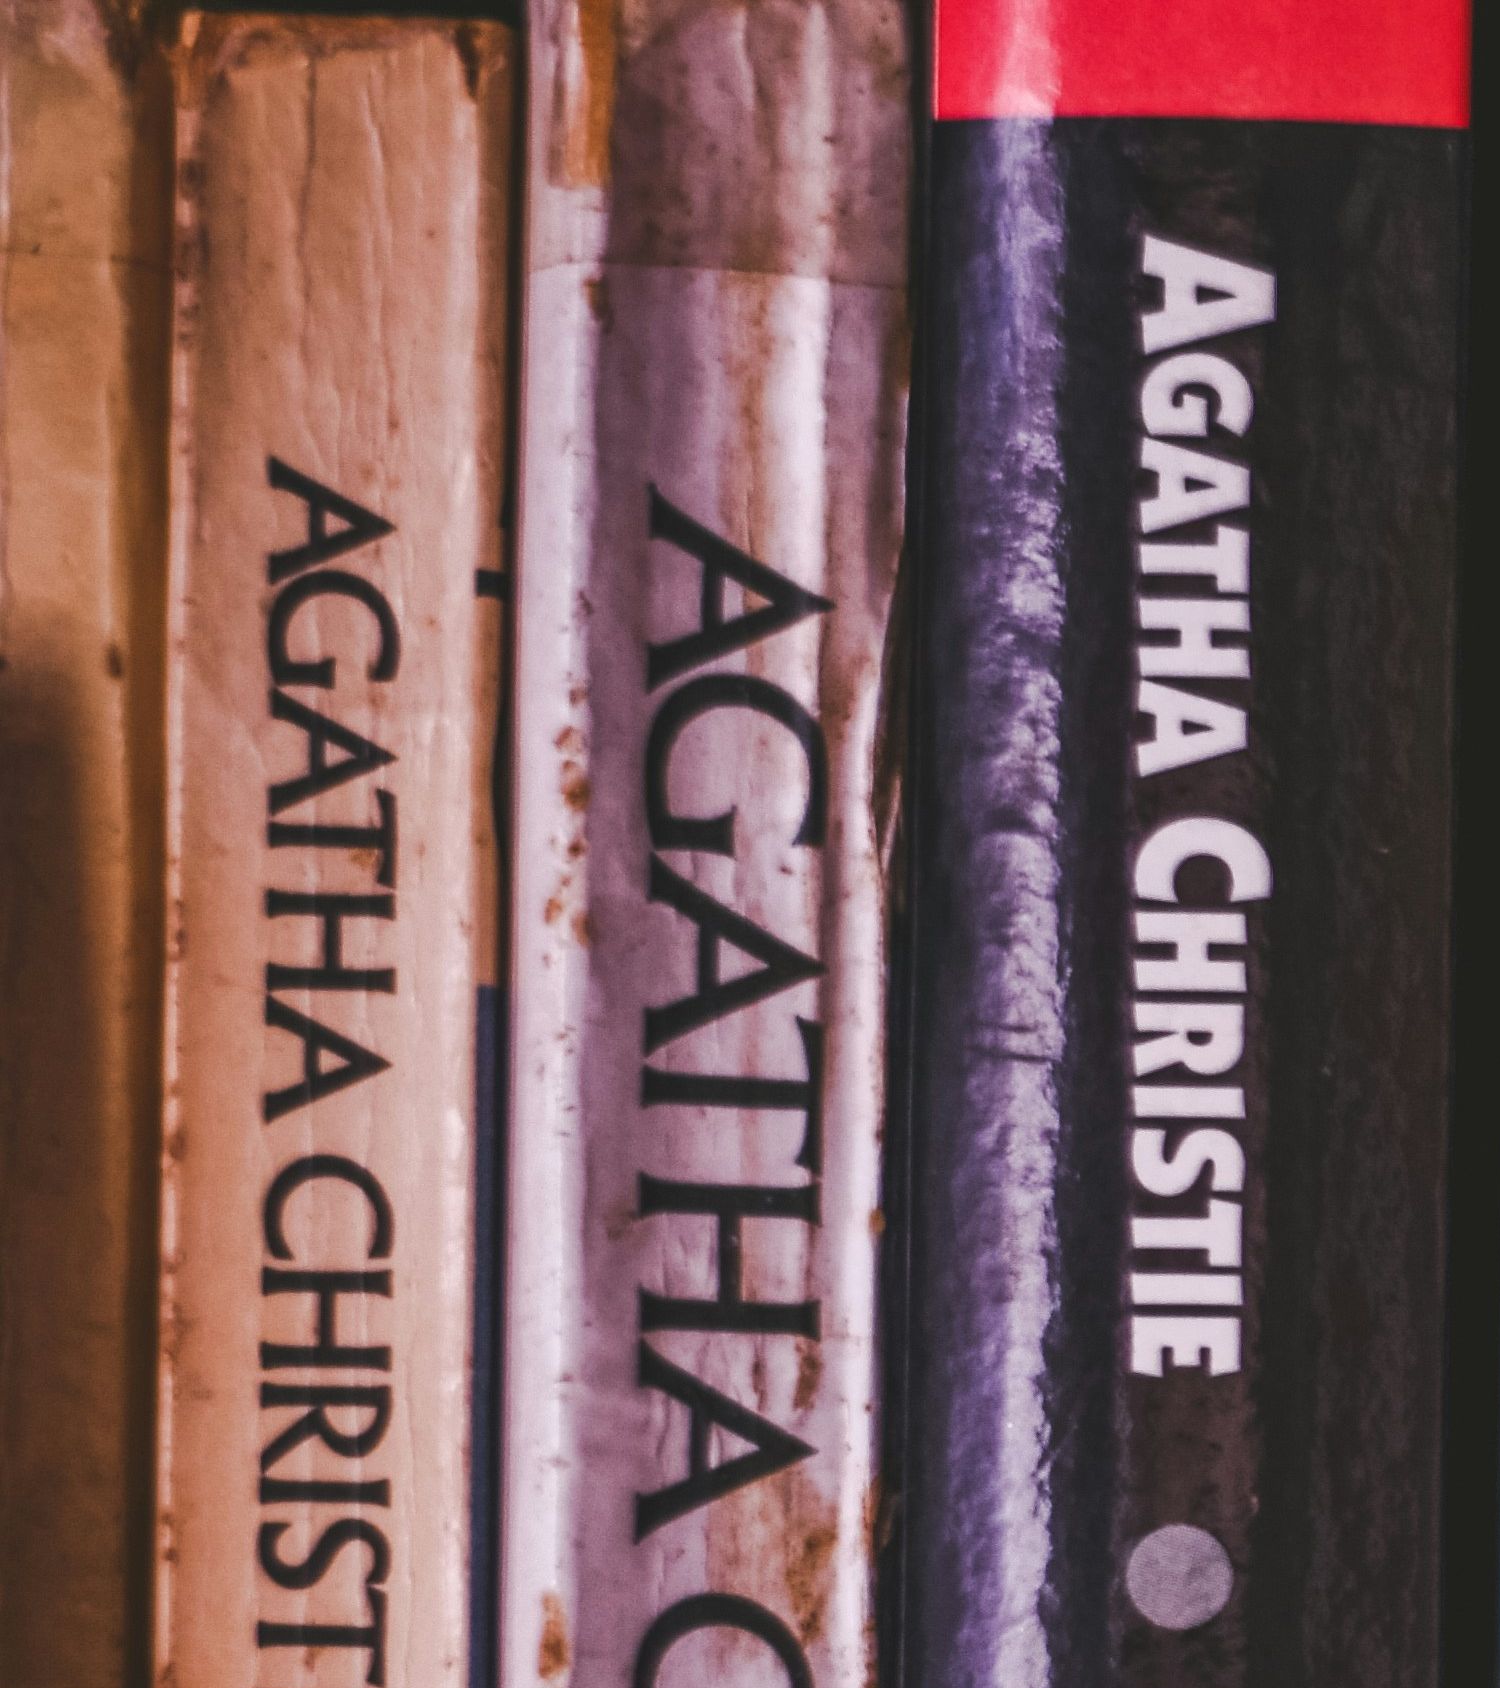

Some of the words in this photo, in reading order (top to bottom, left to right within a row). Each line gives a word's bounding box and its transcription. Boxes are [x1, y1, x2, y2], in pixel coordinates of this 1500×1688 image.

[263, 453, 401, 1124] AGATHA
[1136, 234, 1277, 777] AGATHA
[634, 486, 834, 1544] AGATHA
[1130, 814, 1273, 1379] CHRISTIE
